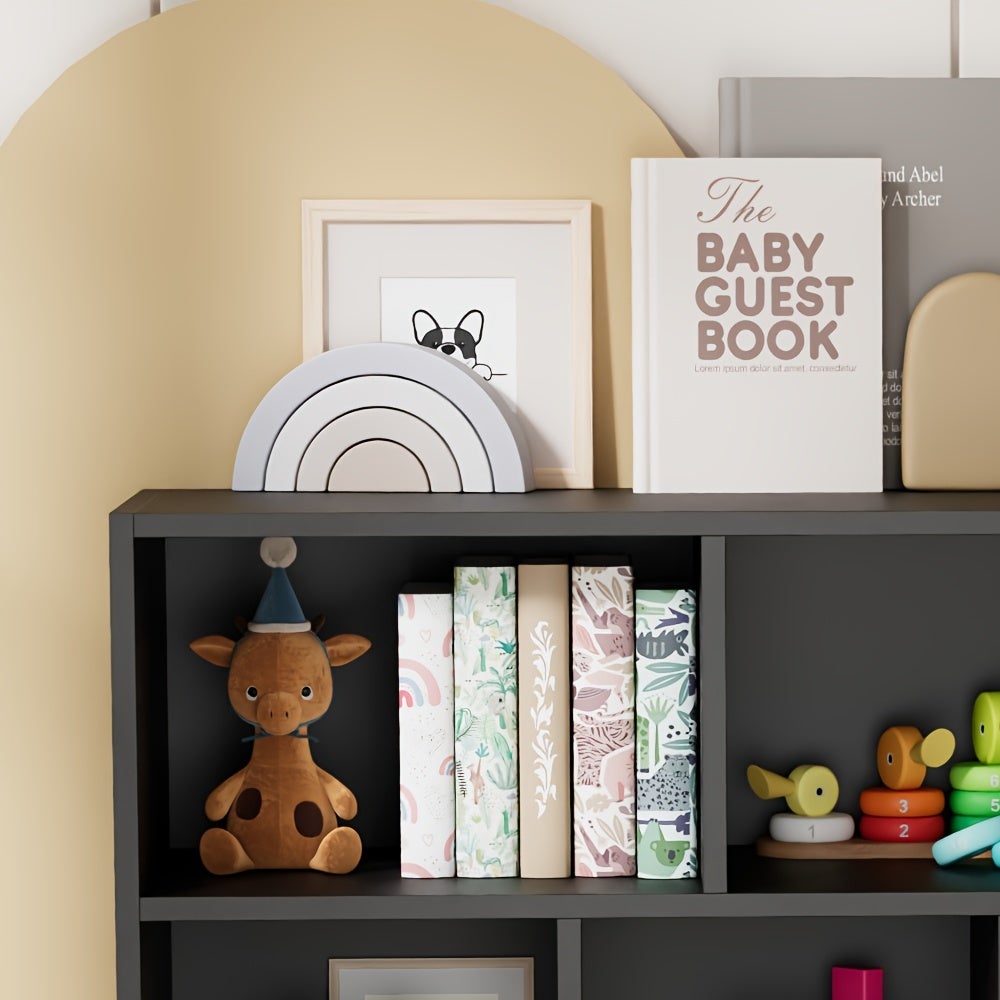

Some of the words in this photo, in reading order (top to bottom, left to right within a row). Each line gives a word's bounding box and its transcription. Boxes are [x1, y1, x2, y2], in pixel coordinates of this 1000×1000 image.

[909, 165, 943, 182] Abel
[696, 176, 776, 224] The
[891, 189, 942, 207] Archer
[697, 232, 824, 273] BABY
[695, 276, 855, 317] GUEST
[697, 320, 839, 361] BOOK
[989, 775, 999, 788] 6
[898, 800, 909, 813] 3
[991, 799, 1000, 812] 5
[808, 825, 815, 839] 1
[899, 824, 909, 838] 2
